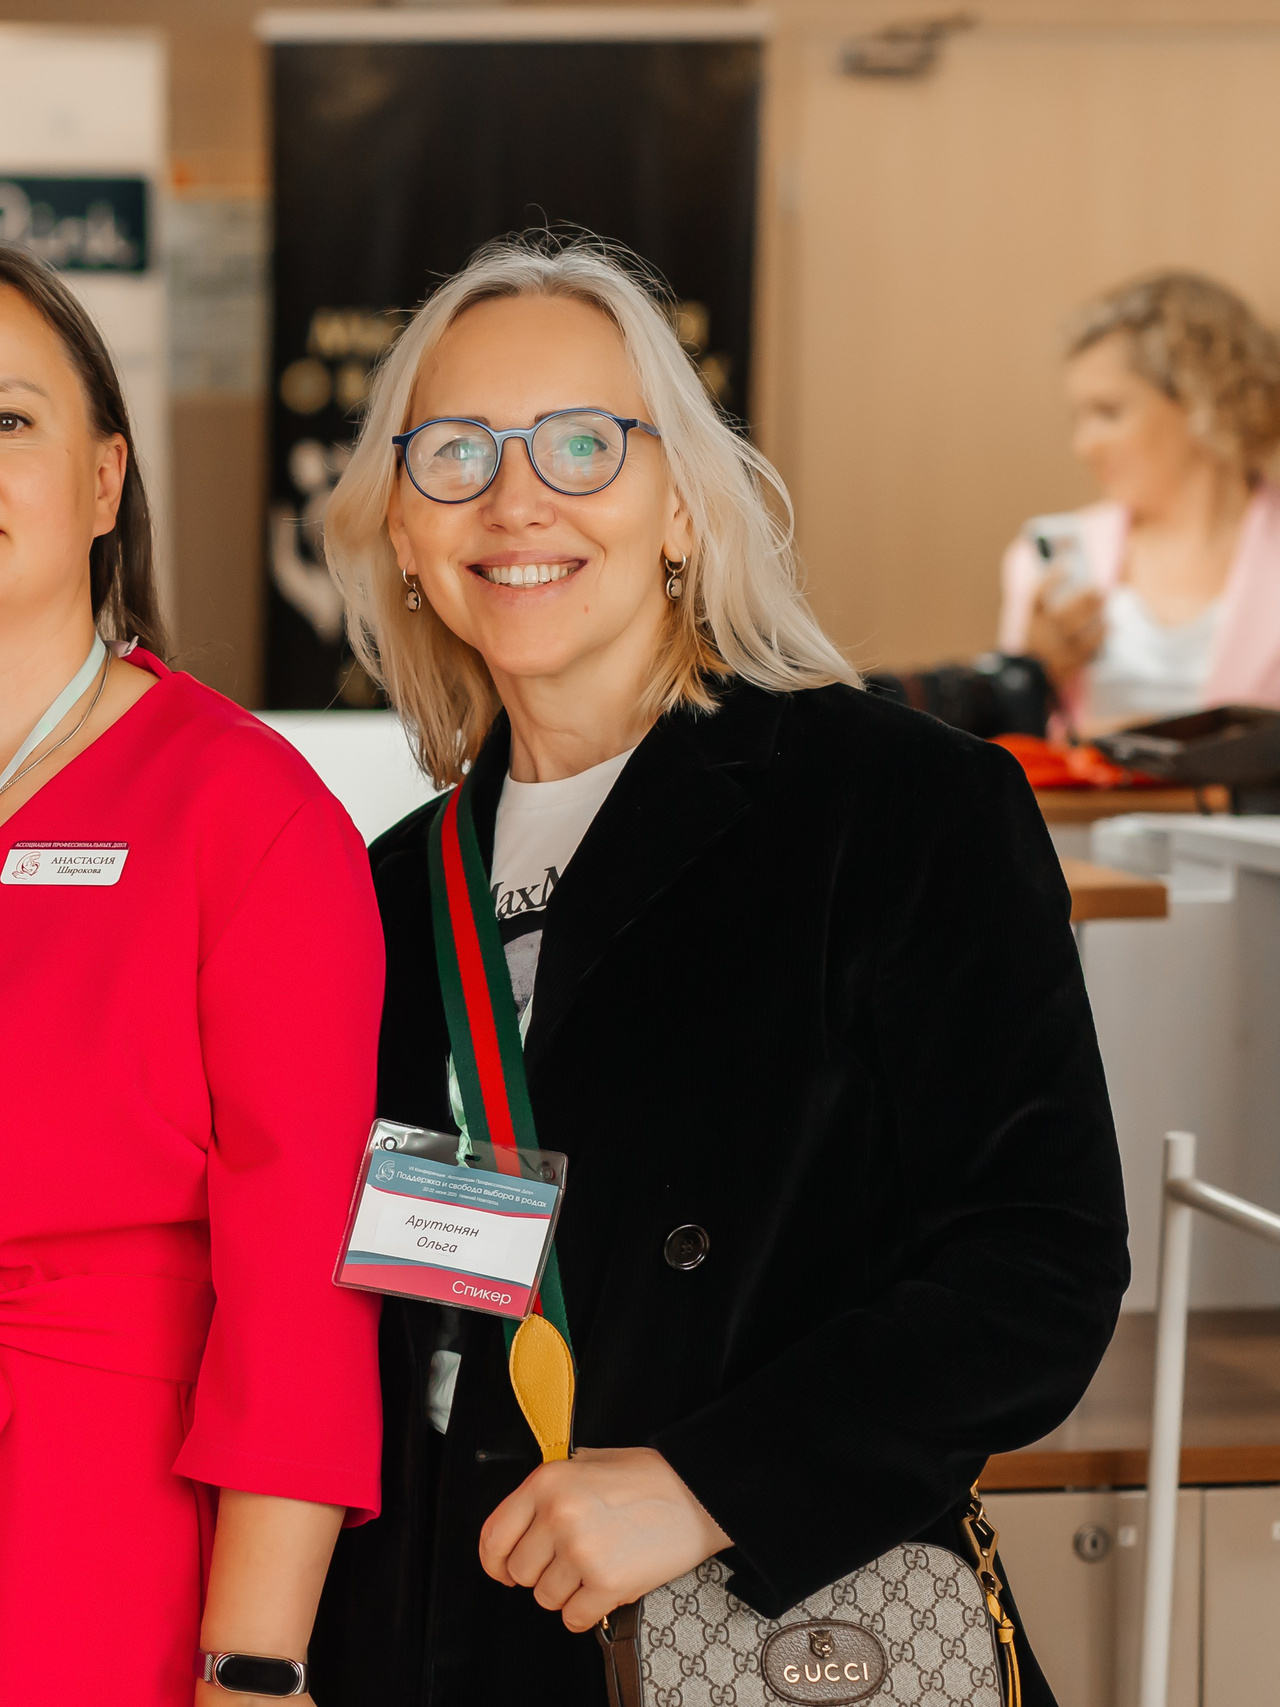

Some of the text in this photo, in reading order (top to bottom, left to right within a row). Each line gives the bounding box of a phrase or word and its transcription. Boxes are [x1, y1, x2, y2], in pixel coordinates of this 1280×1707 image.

[51, 856, 116, 865] АНАСТАСИЯ
[57, 866, 101, 876] Широкова
[396, 1171, 441, 1187] Поддержка
[448, 1182, 482, 1194] свобода
[483, 1188, 515, 1201] выбора
[521, 1197, 547, 1208] родах
[404, 1214, 480, 1238] Арутюнян
[416, 1236, 458, 1253] Ольга
[451, 1280, 512, 1306] Спикер
[783, 1662, 869, 1684] GUCCI
